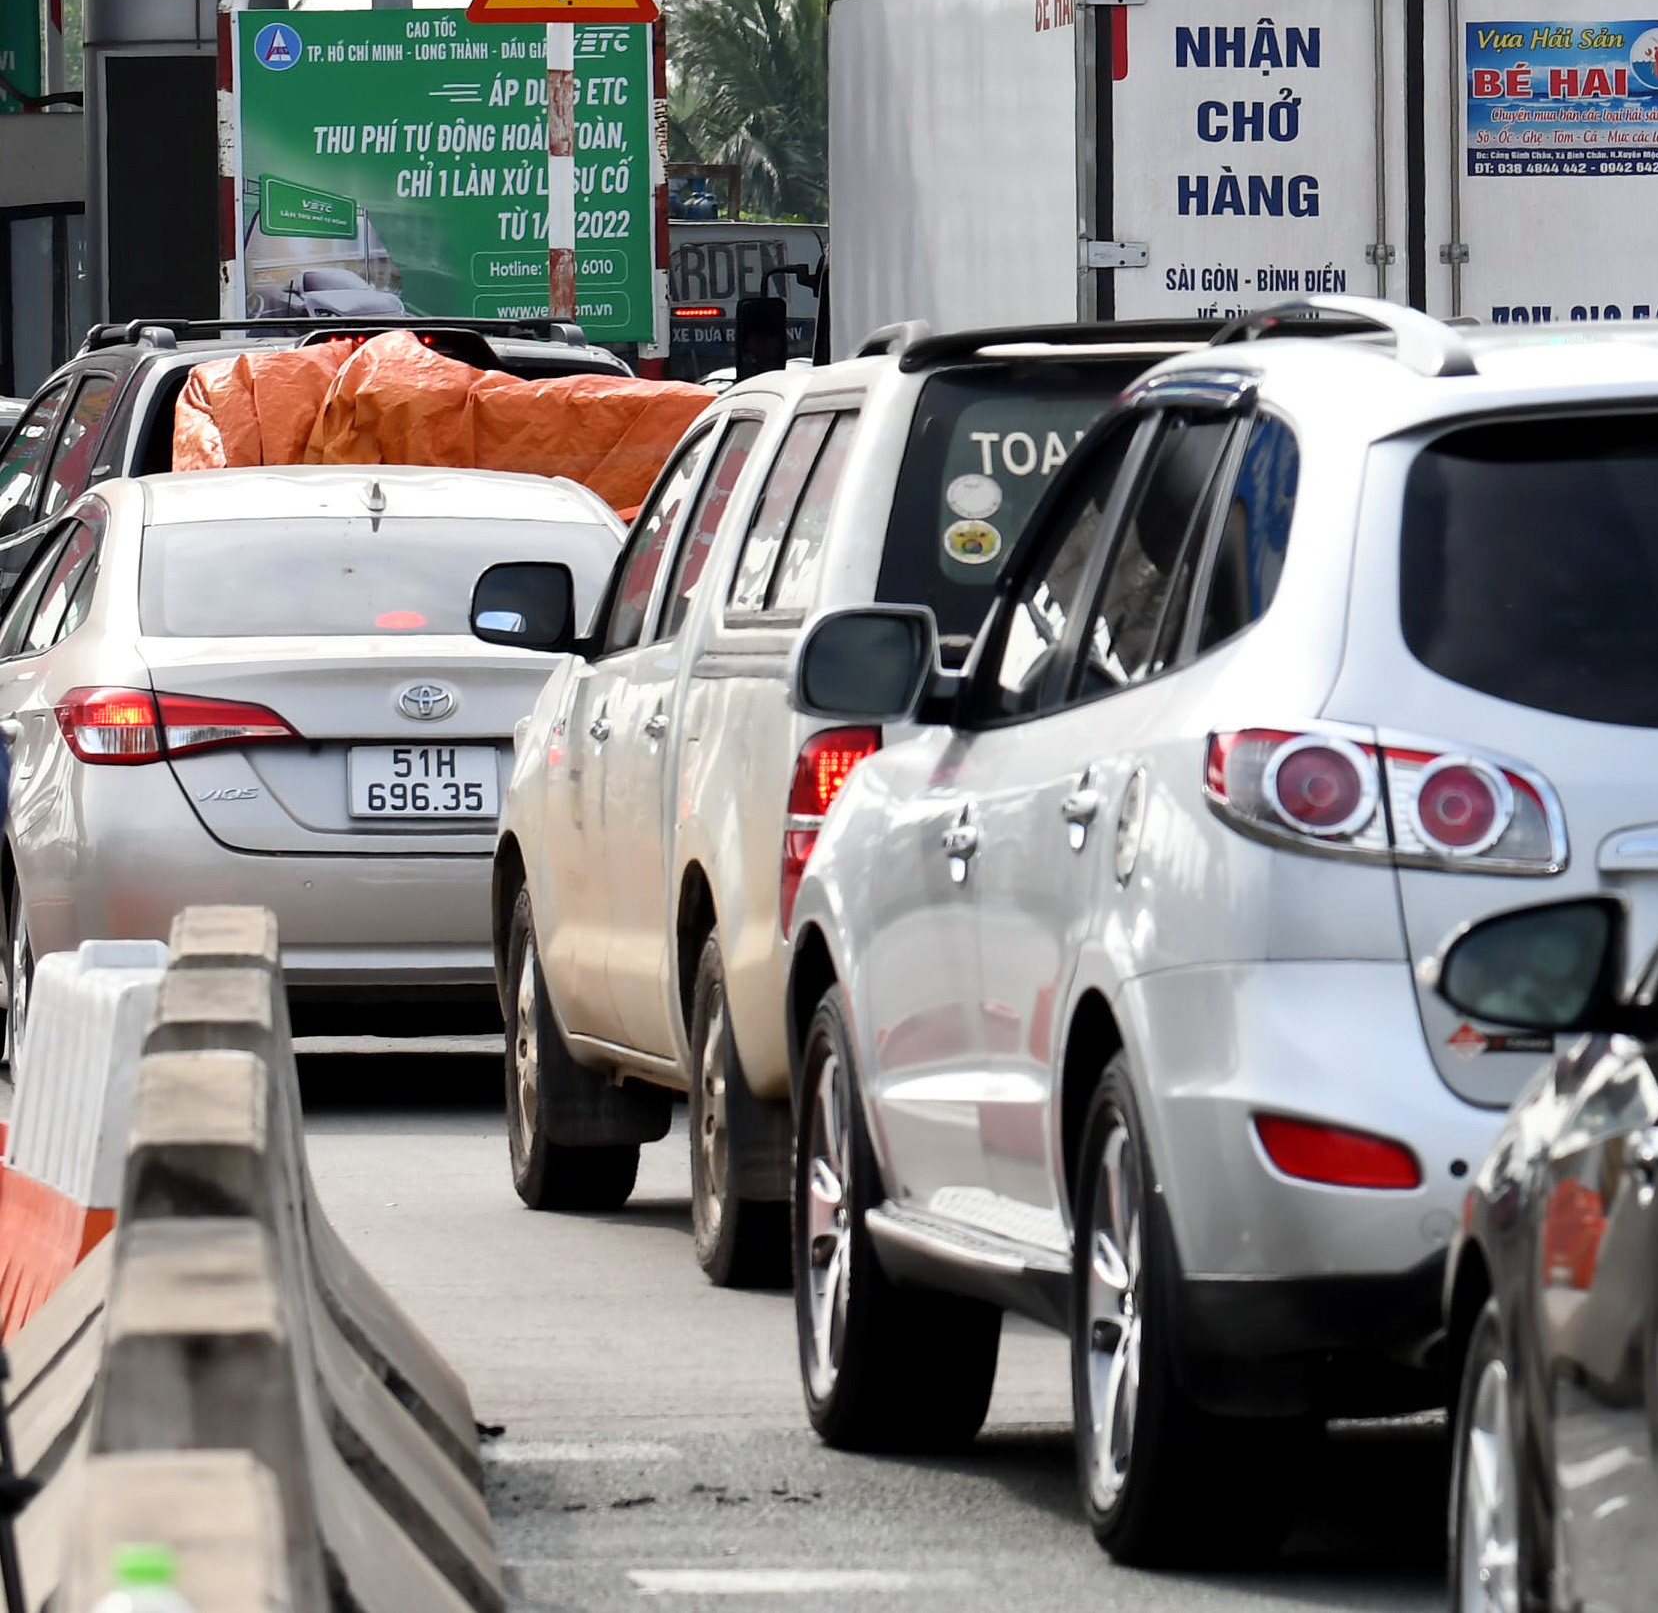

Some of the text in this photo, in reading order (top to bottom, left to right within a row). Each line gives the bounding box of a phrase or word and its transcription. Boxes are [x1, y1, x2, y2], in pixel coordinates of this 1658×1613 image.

[406, 16, 457, 38] CAO TỐC
[1477, 27, 1624, 53] Vựa Hải Sản
[307, 45, 324, 62] TP.
[348, 40, 369, 62] CHÍ
[372, 45, 403, 61] MINH
[415, 43, 446, 60] LONG
[450, 38, 488, 60] THÀNH
[1175, 17, 1321, 77] NHẬN
[488, 72, 629, 107] ÁP ETC
[1472, 62, 1629, 98] BÉ HAI
[1197, 87, 1302, 142] CHỞ
[1491, 106, 1531, 123] Chuyên
[1533, 110, 1557, 121] mua
[313, 115, 549, 162] THU PHÍ TỰ ĐỘNG HOÀ
[397, 161, 434, 198] CHỈ
[438, 170, 448, 196] 1
[452, 163, 496, 196] LÀN
[501, 159, 534, 196] XỬ
[601, 155, 634, 194] CỐ
[1474, 162, 1494, 174] ĐT:
[1498, 163, 1522, 174] 038
[1526, 163, 1559, 174] 4844
[1563, 163, 1587, 173] 442
[1600, 163, 1633, 173] 0942
[1177, 165, 1320, 218] HÀNG
[498, 205, 529, 240] TỪ
[490, 260, 542, 277] Hotline:
[581, 259, 613, 274] 6010
[1166, 264, 1195, 292] SÀI
[1201, 263, 1238, 292] GÒN
[1257, 263, 1299, 292] BÌNH
[673, 328, 690, 342] XE
[970, 430, 1086, 476] TOA
[393, 748, 456, 778] 51H
[198, 787, 259, 803] VIOS
[368, 782, 483, 812] 696.35
